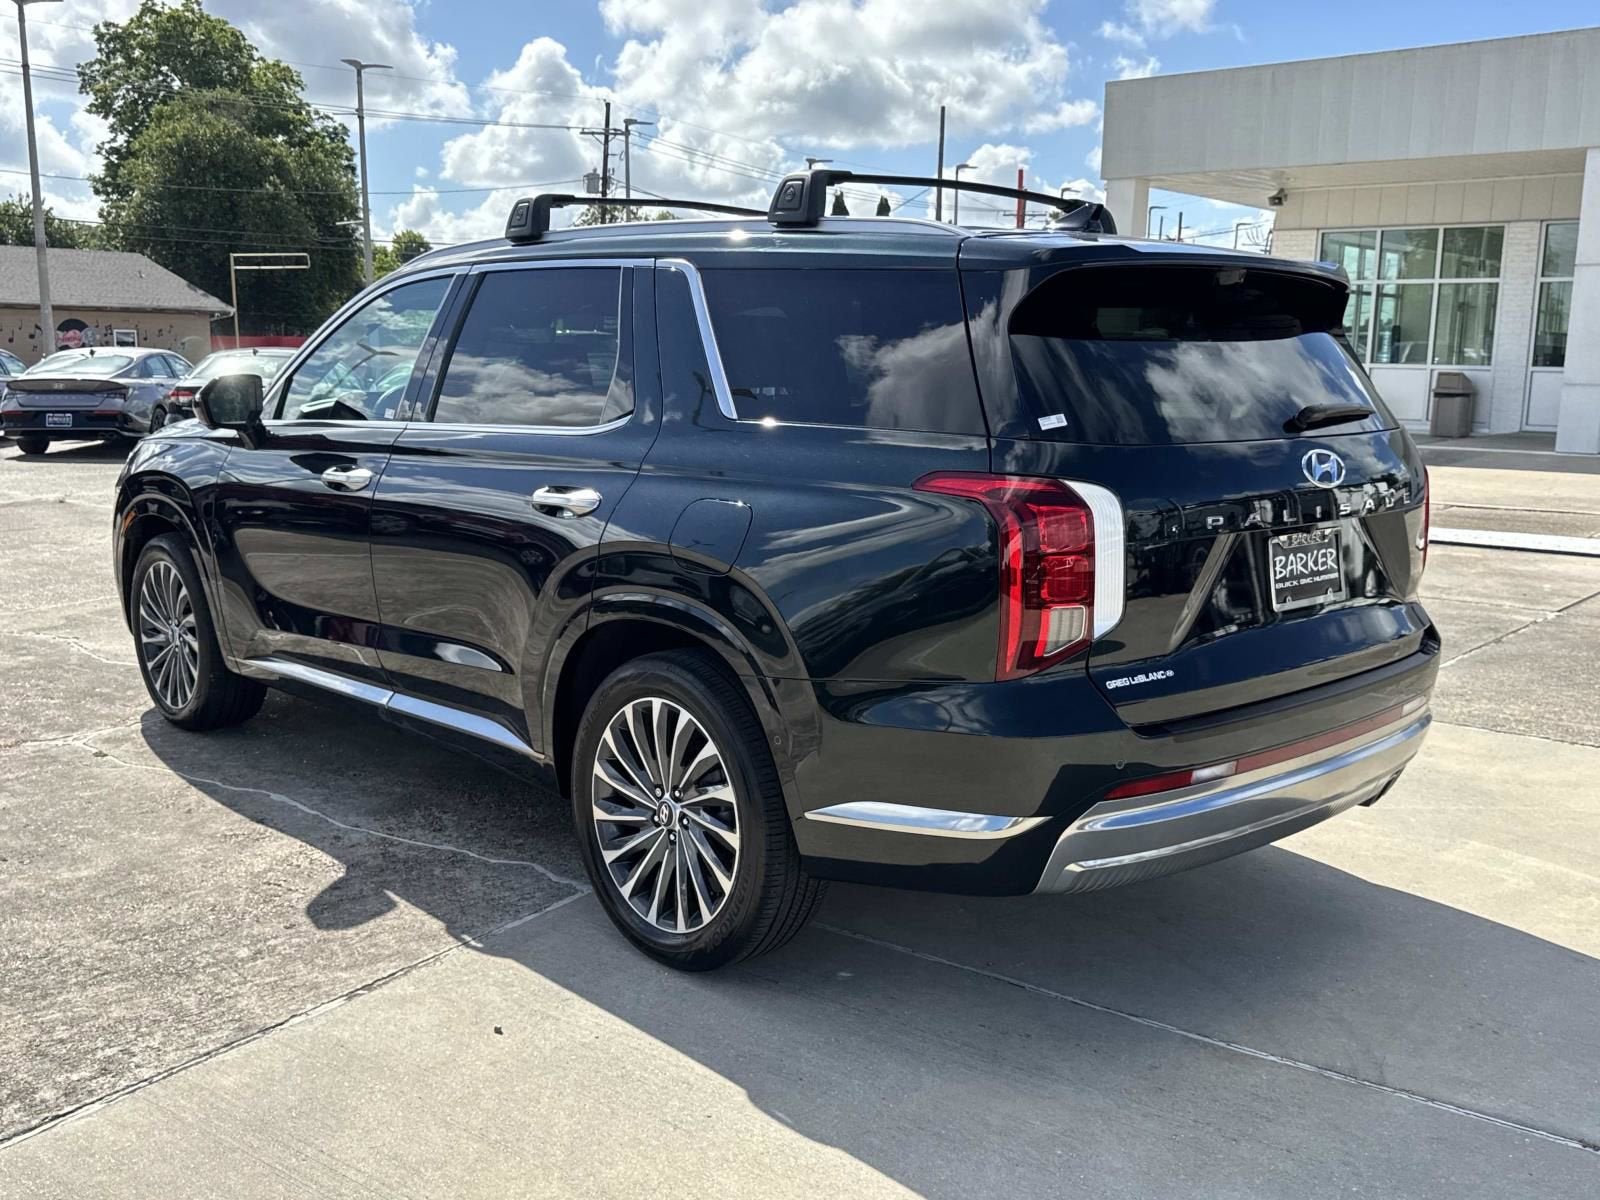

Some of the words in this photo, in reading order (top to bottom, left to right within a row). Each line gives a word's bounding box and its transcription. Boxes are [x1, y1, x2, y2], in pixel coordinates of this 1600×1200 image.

[1206, 491, 1410, 529] PALISADE
[1274, 549, 1338, 579] BARKER
[1275, 580, 1299, 589] BUICK
[1106, 677, 1130, 689] GREG
